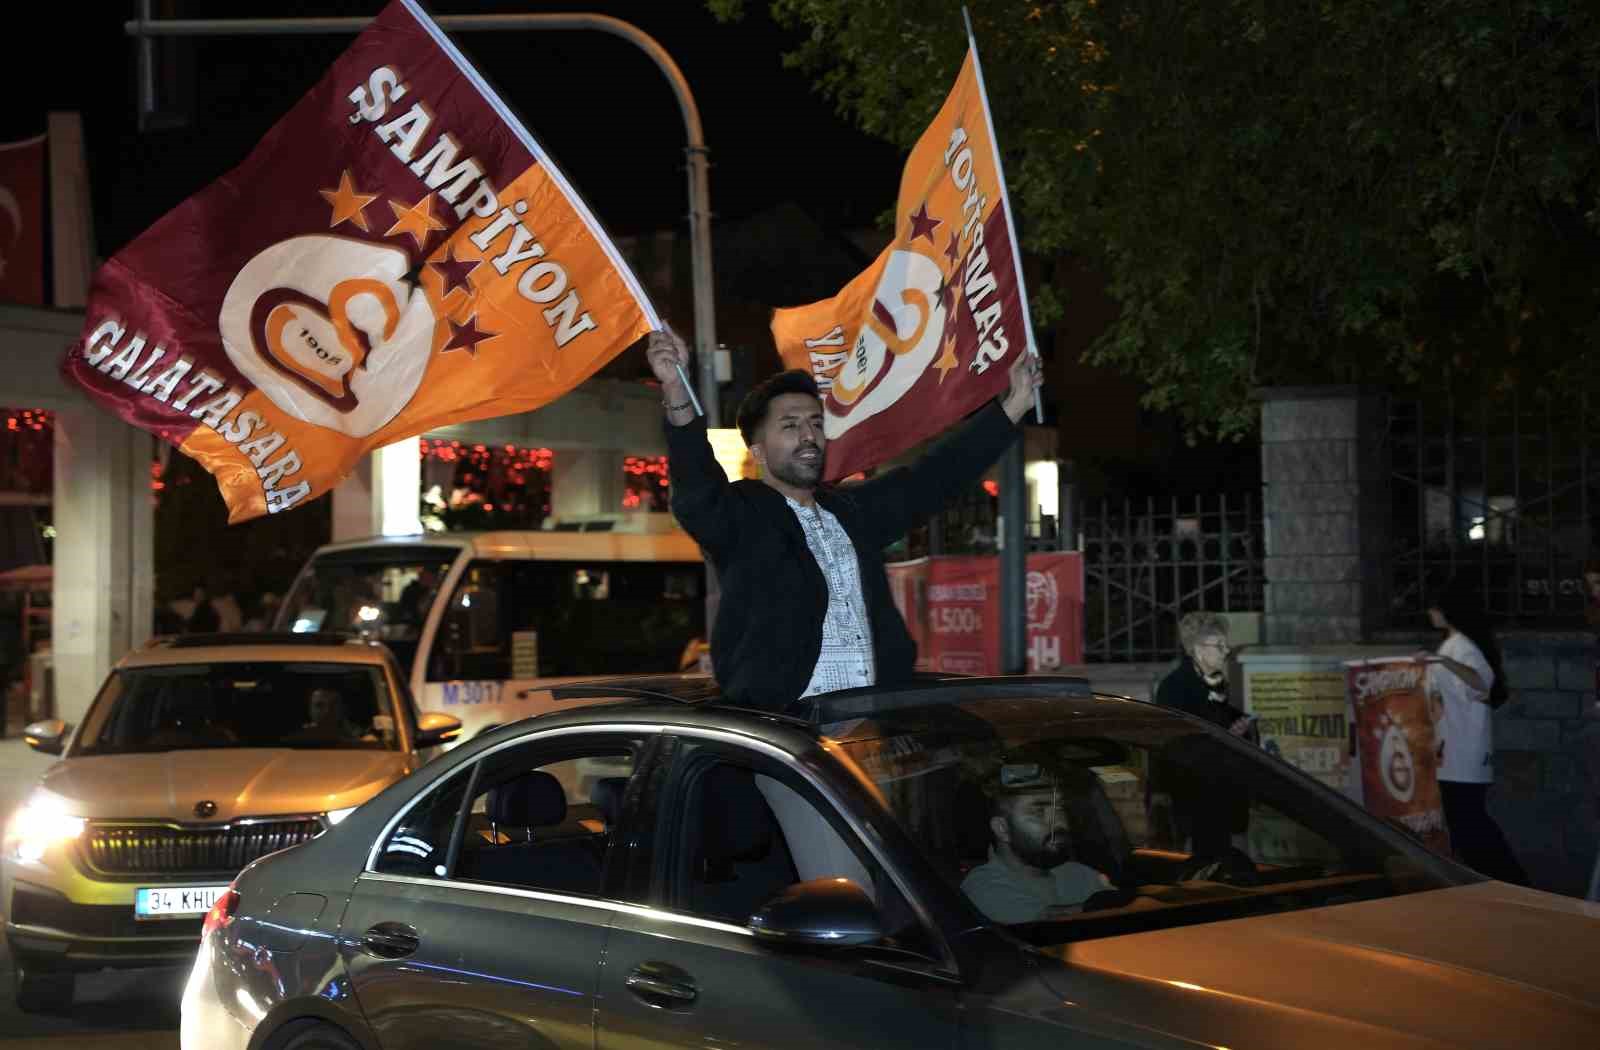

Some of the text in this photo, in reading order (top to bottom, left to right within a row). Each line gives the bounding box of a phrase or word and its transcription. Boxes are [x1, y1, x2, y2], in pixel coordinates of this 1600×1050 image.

[349, 66, 596, 347] ŞAMPİYON
[84, 319, 311, 514] GALATASARA
[151, 892, 171, 910] 34
